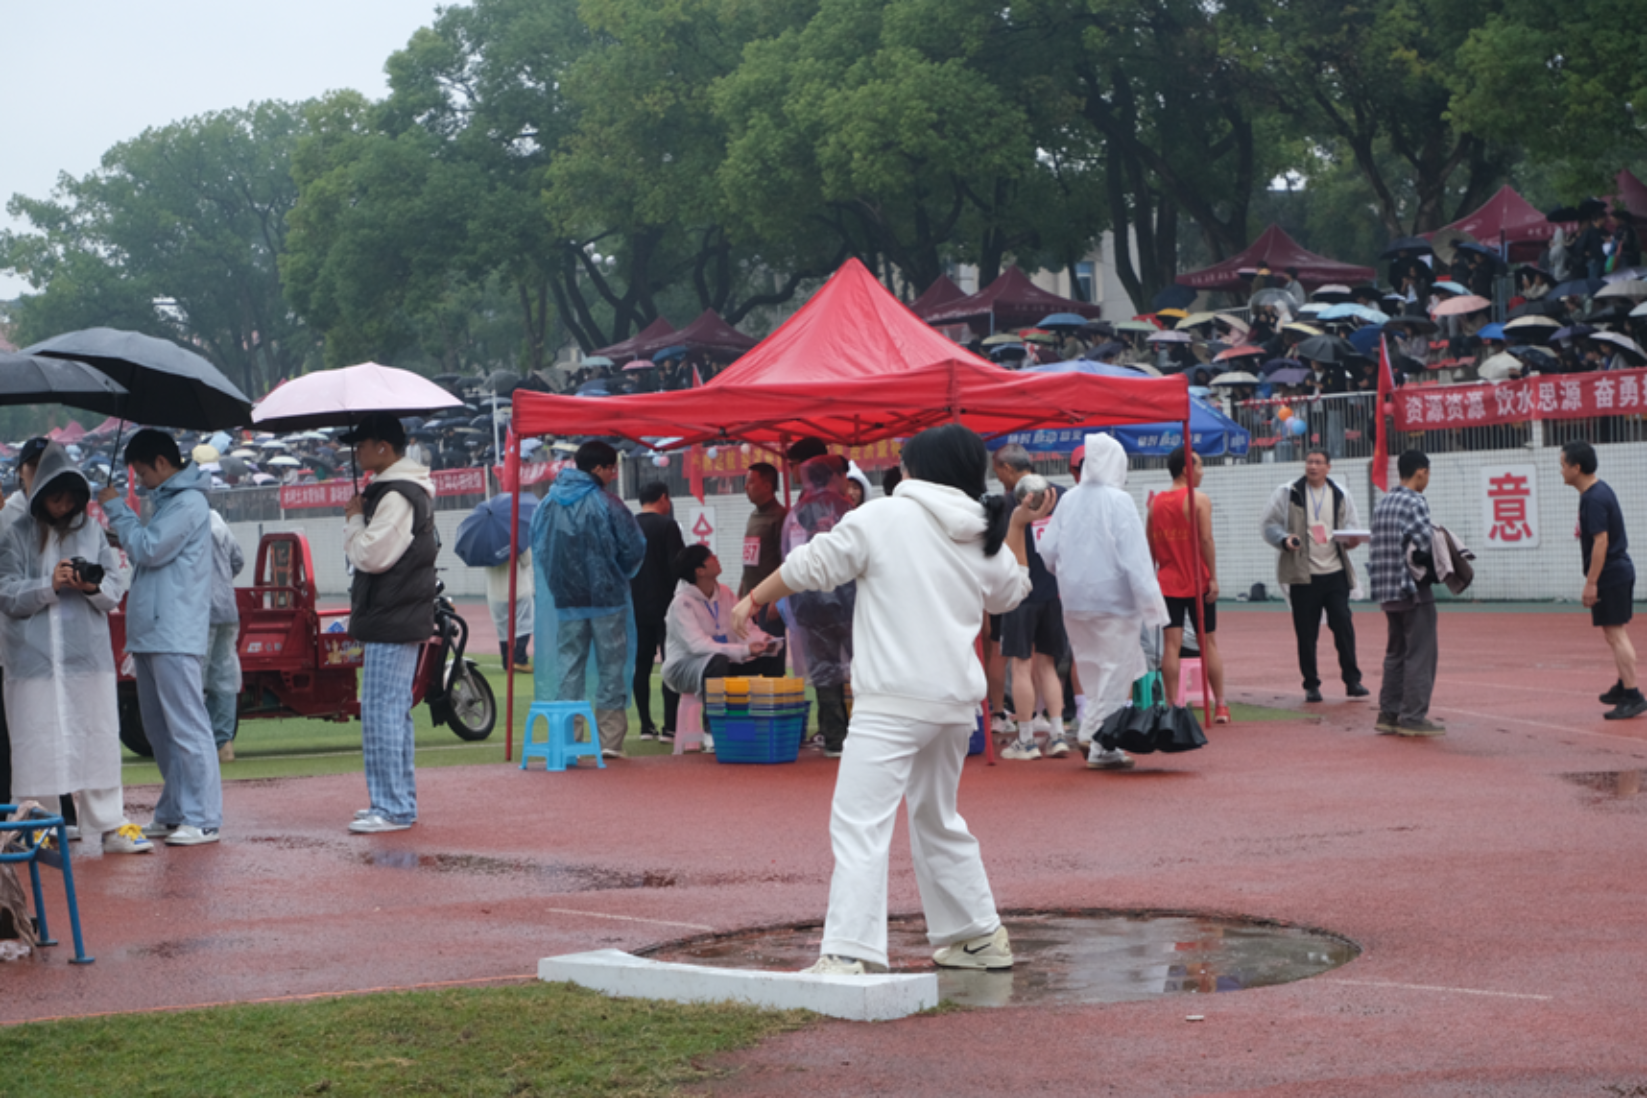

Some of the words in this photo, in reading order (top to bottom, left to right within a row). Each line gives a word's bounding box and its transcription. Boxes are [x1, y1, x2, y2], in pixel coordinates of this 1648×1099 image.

[1405, 391, 1486, 425] 资源资源
[1495, 382, 1582, 416] 饮水思源
[1594, 374, 1647, 409] 奋勇
[1487, 472, 1533, 542] 意
